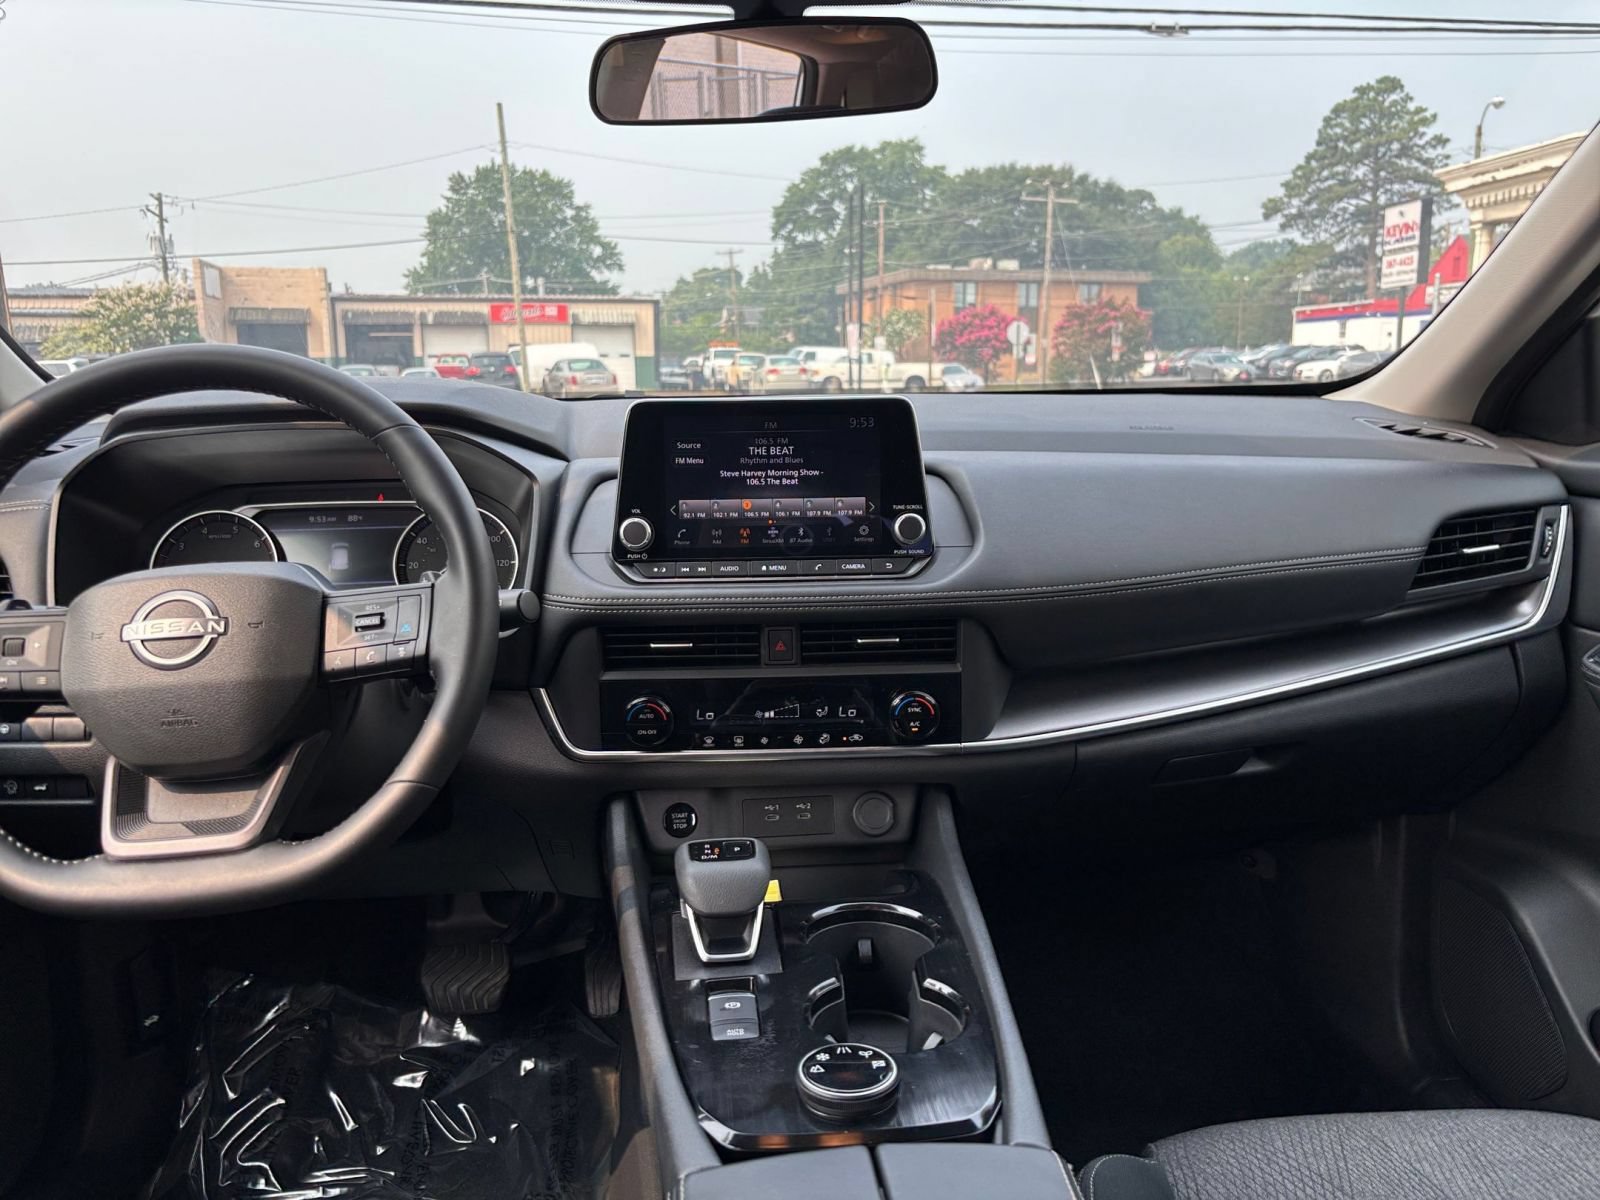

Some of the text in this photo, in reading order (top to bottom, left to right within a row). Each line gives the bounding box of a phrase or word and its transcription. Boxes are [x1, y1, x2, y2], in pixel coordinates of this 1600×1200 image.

[764, 421, 777, 429] FM
[849, 416, 875, 428] 9:53
[676, 441, 702, 449] Source
[748, 445, 795, 455] THE BEAT
[740, 457, 768, 465] Rhythm
[769, 456, 783, 464] and
[719, 469, 740, 478] Steve
[740, 469, 767, 478] Harvey
[767, 469, 799, 477] Morning
[799, 468, 820, 476] Show
[746, 478, 765, 486] 106.5
[781, 477, 799, 485] Beat
[308, 515, 326, 523] 9:53
[416, 537, 428, 545] 40
[179, 542, 185, 550] 3
[408, 561, 419, 569] 20
[496, 559, 510, 567] 120
[125, 619, 226, 636] NISSAN
